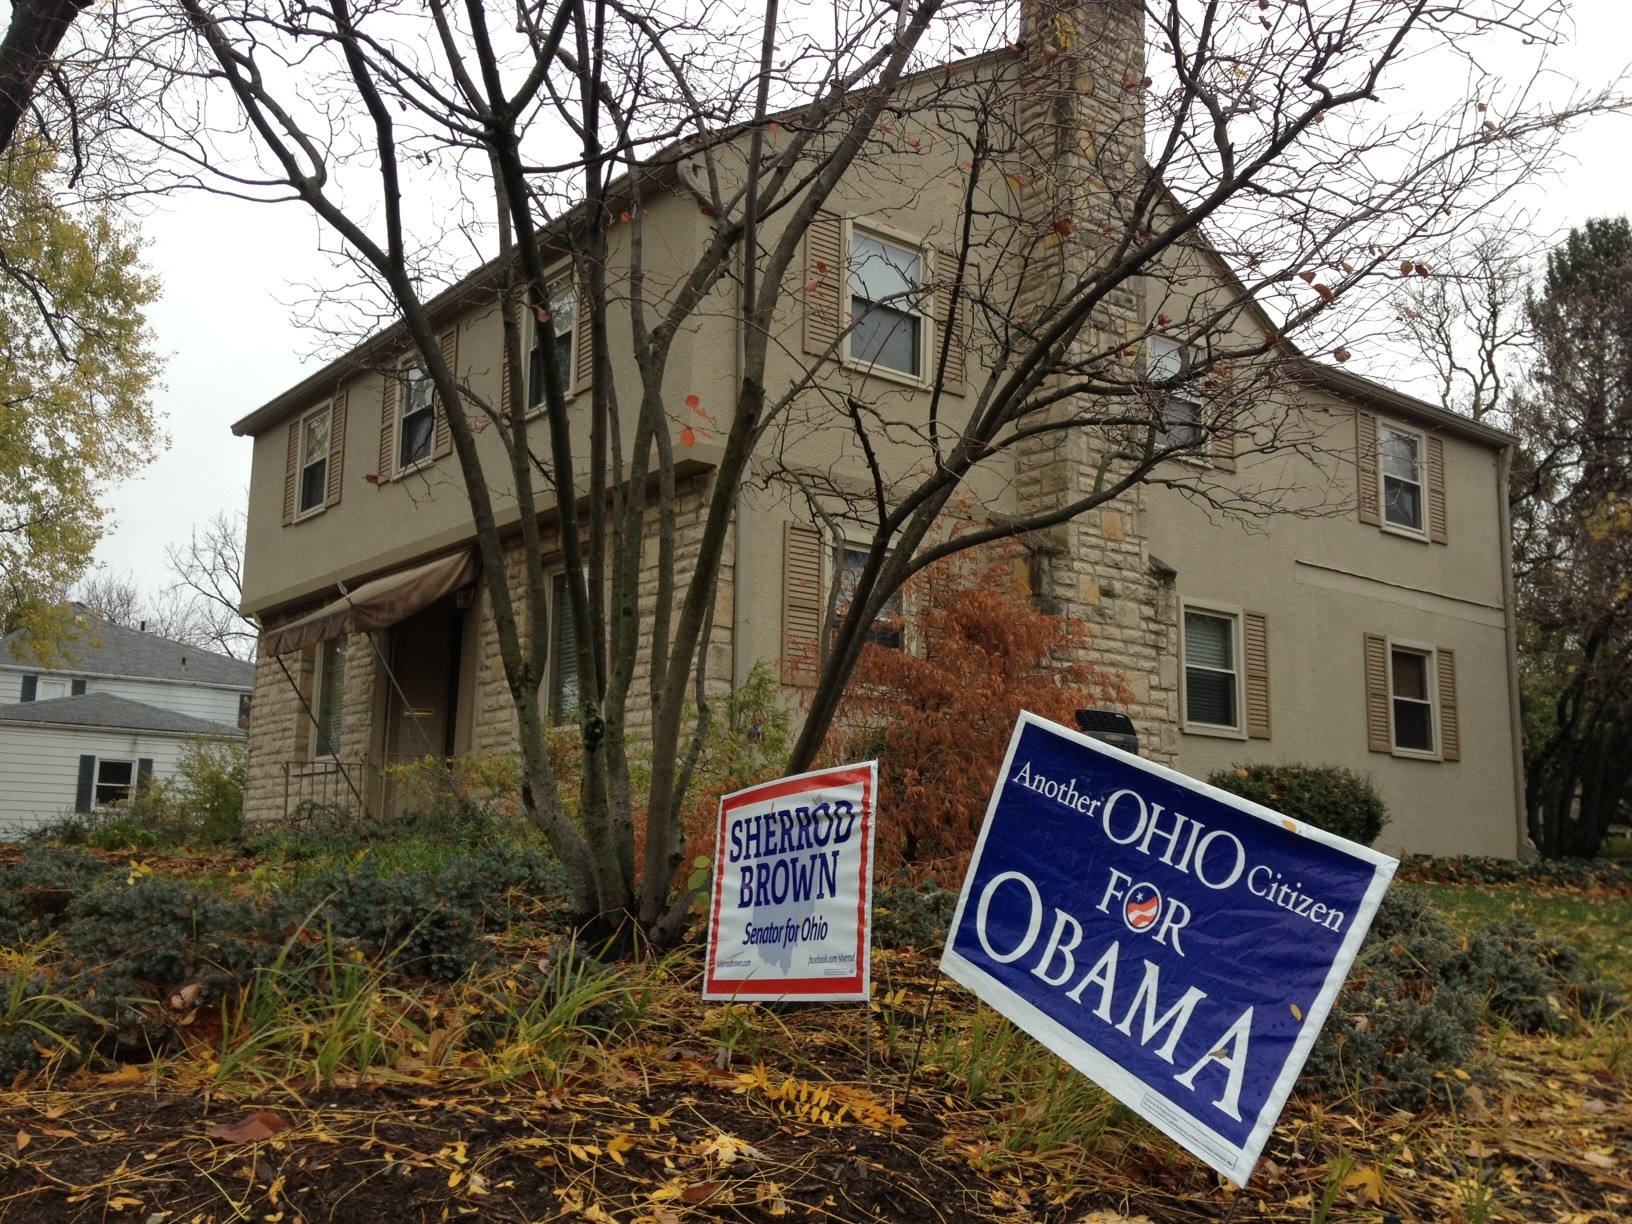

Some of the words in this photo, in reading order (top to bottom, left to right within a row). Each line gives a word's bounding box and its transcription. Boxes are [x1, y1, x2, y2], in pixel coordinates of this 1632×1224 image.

[729, 800, 855, 863] SHERROD
[1013, 761, 1102, 818] Another
[1102, 789, 1245, 890] OHIO
[1247, 865, 1345, 933] Citizen
[738, 850, 839, 909] BROWN
[1096, 867, 1191, 957] FOR
[742, 922, 782, 945] Senator
[783, 917, 800, 948] for
[801, 915, 828, 942] Ohio
[976, 870, 1254, 1123] OBAMA
